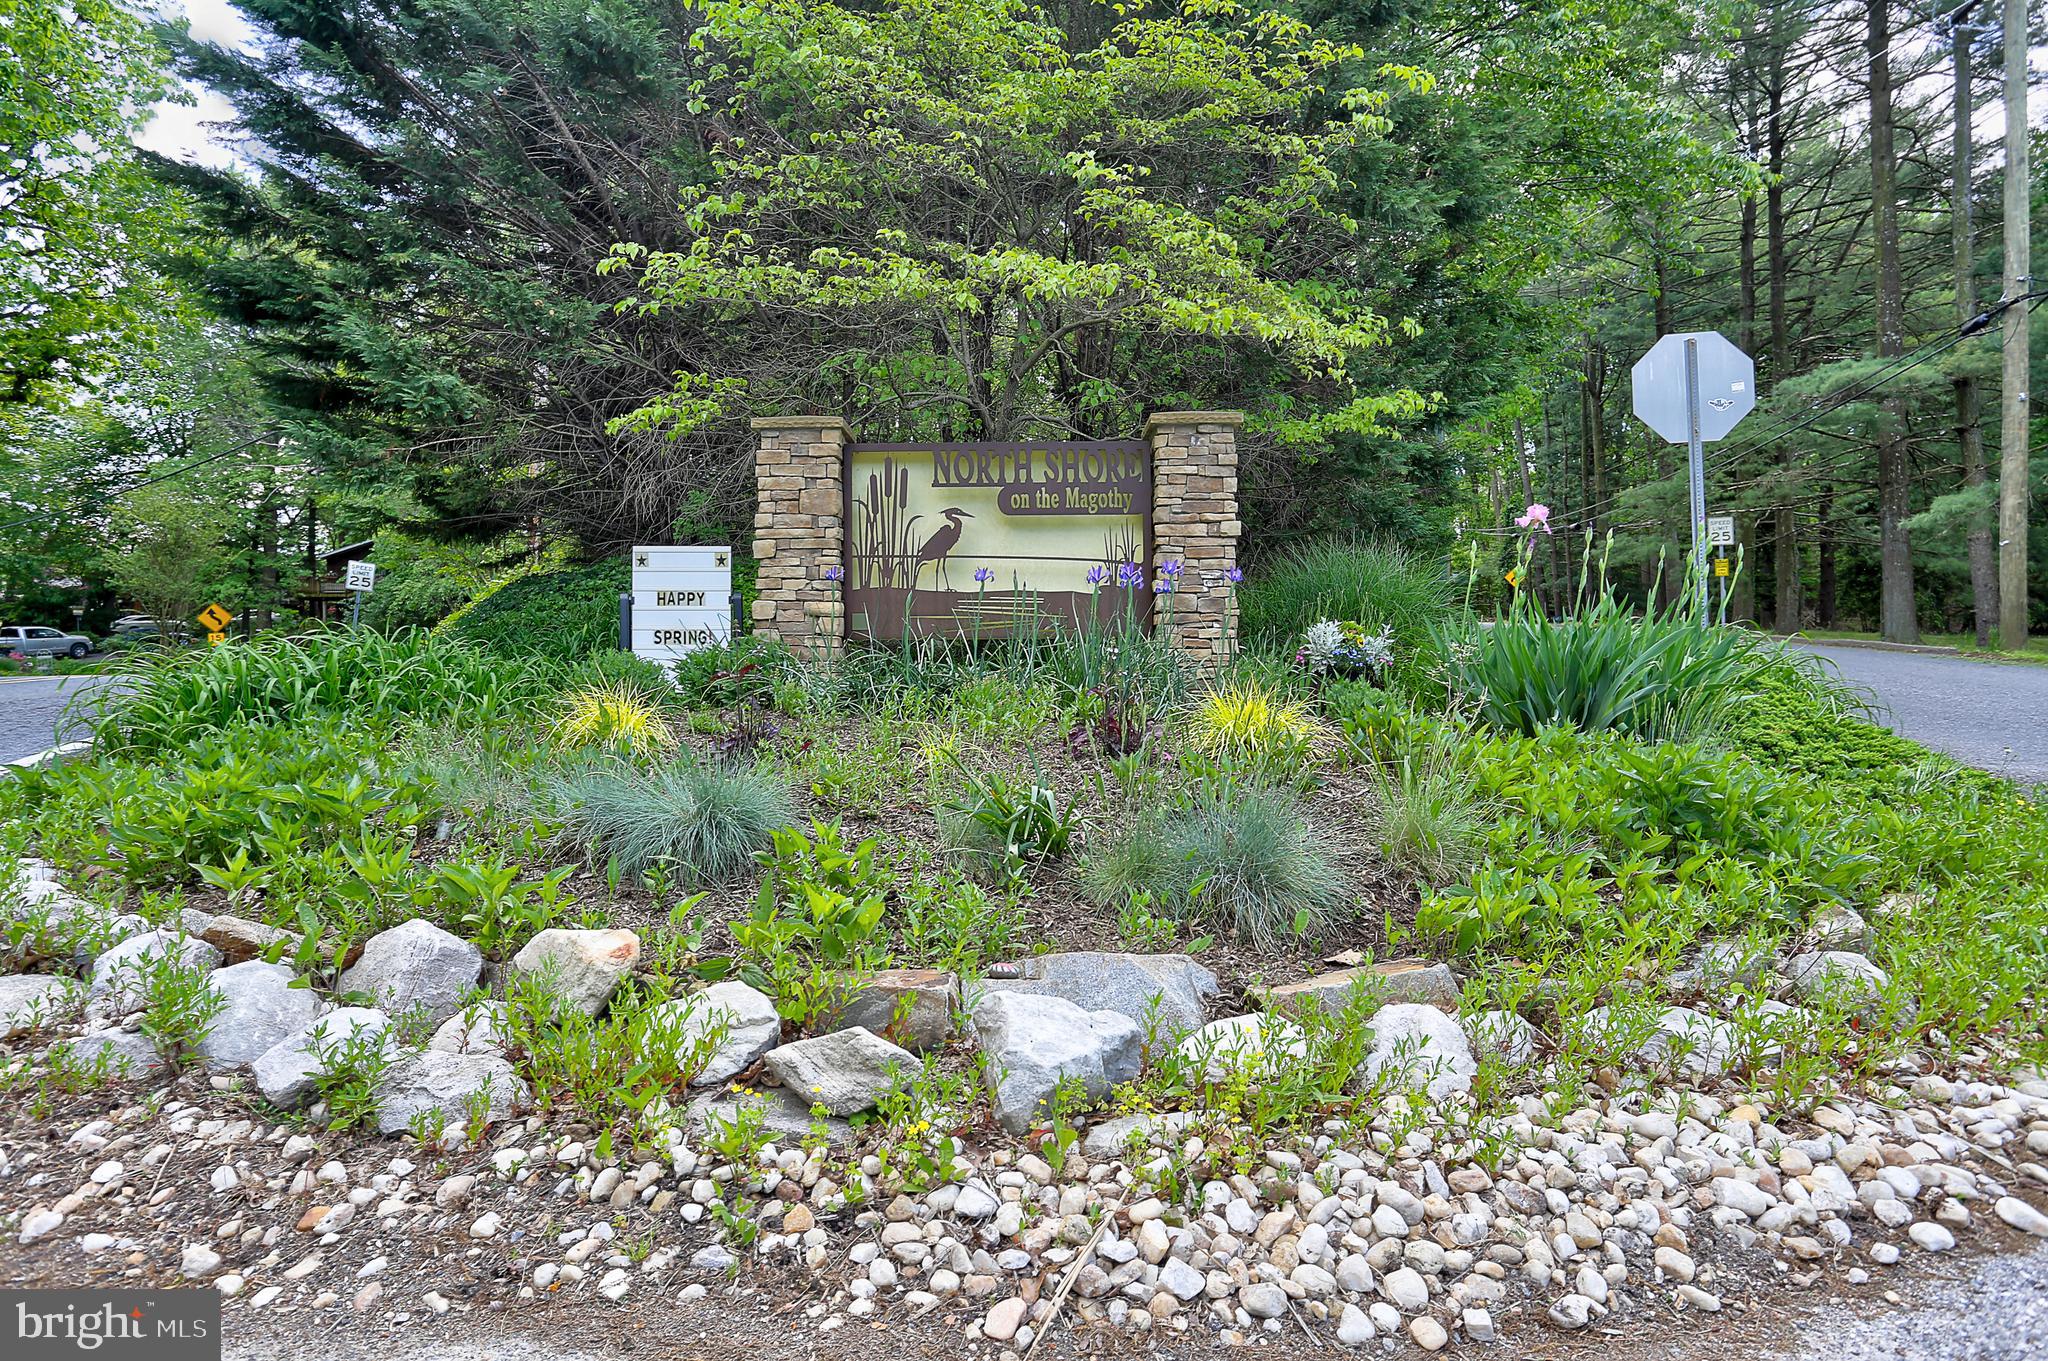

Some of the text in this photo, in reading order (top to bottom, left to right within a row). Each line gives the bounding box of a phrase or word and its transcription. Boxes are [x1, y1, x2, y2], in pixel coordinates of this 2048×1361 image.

[932, 450, 1144, 484] NORTH SHORE
[1010, 487, 1134, 514] on the Magothy
[1711, 531, 1731, 542] 25
[350, 576, 371, 588] 25
[657, 591, 705, 606] HAPPY
